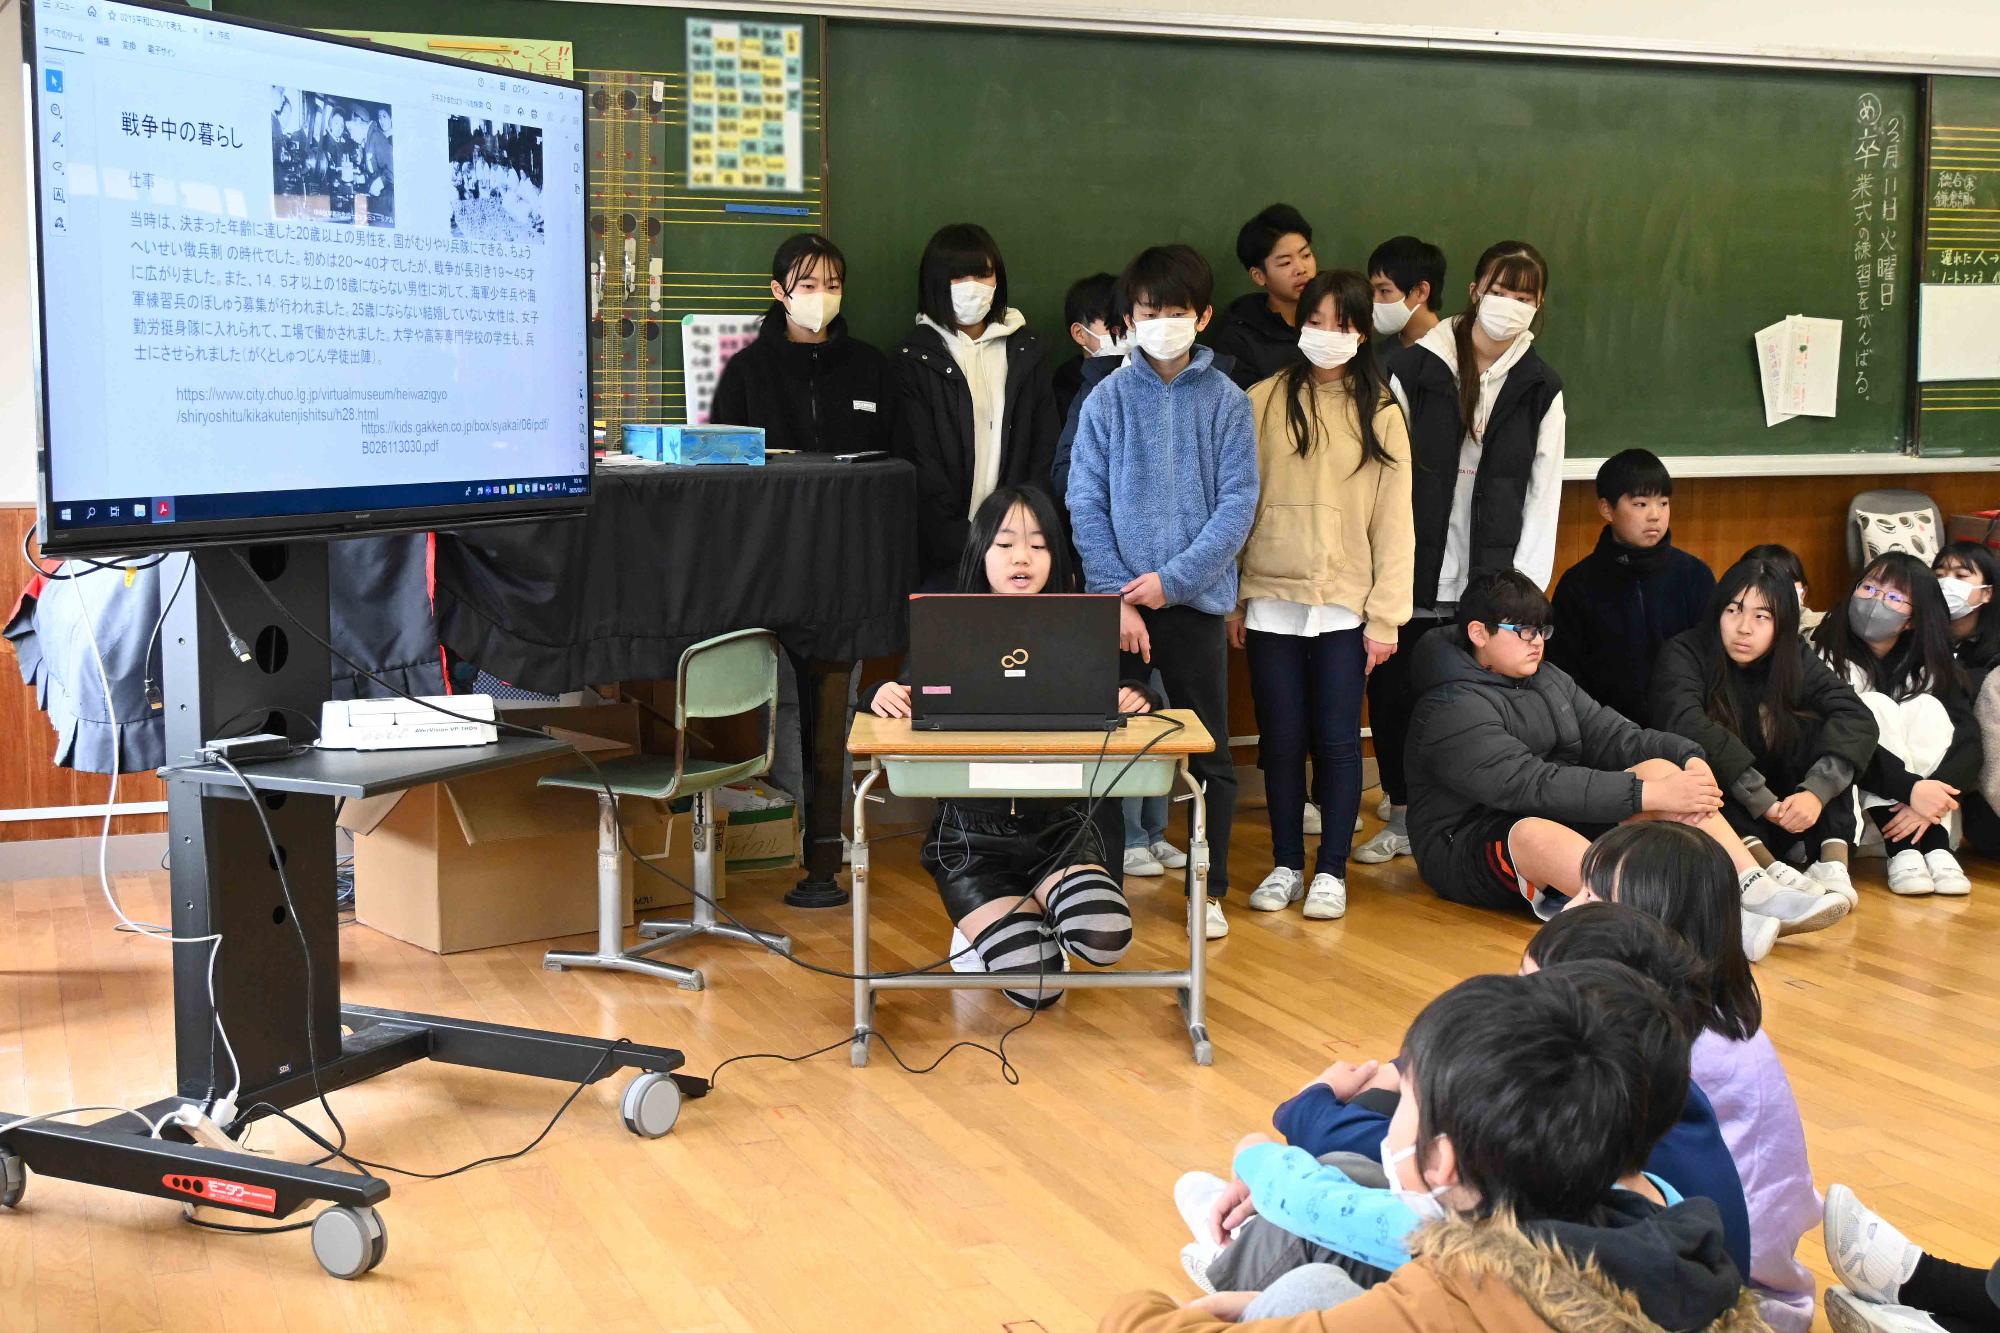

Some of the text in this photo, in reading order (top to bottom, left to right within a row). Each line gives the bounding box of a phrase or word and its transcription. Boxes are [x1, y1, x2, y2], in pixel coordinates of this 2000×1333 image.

[121, 111, 244, 149] 戦争中の暮らし
[128, 170, 155, 189] 仕事
[176, 386, 448, 405] https://www.city.chuo.lg.jp/virtualmuseum/heiwazigyo
